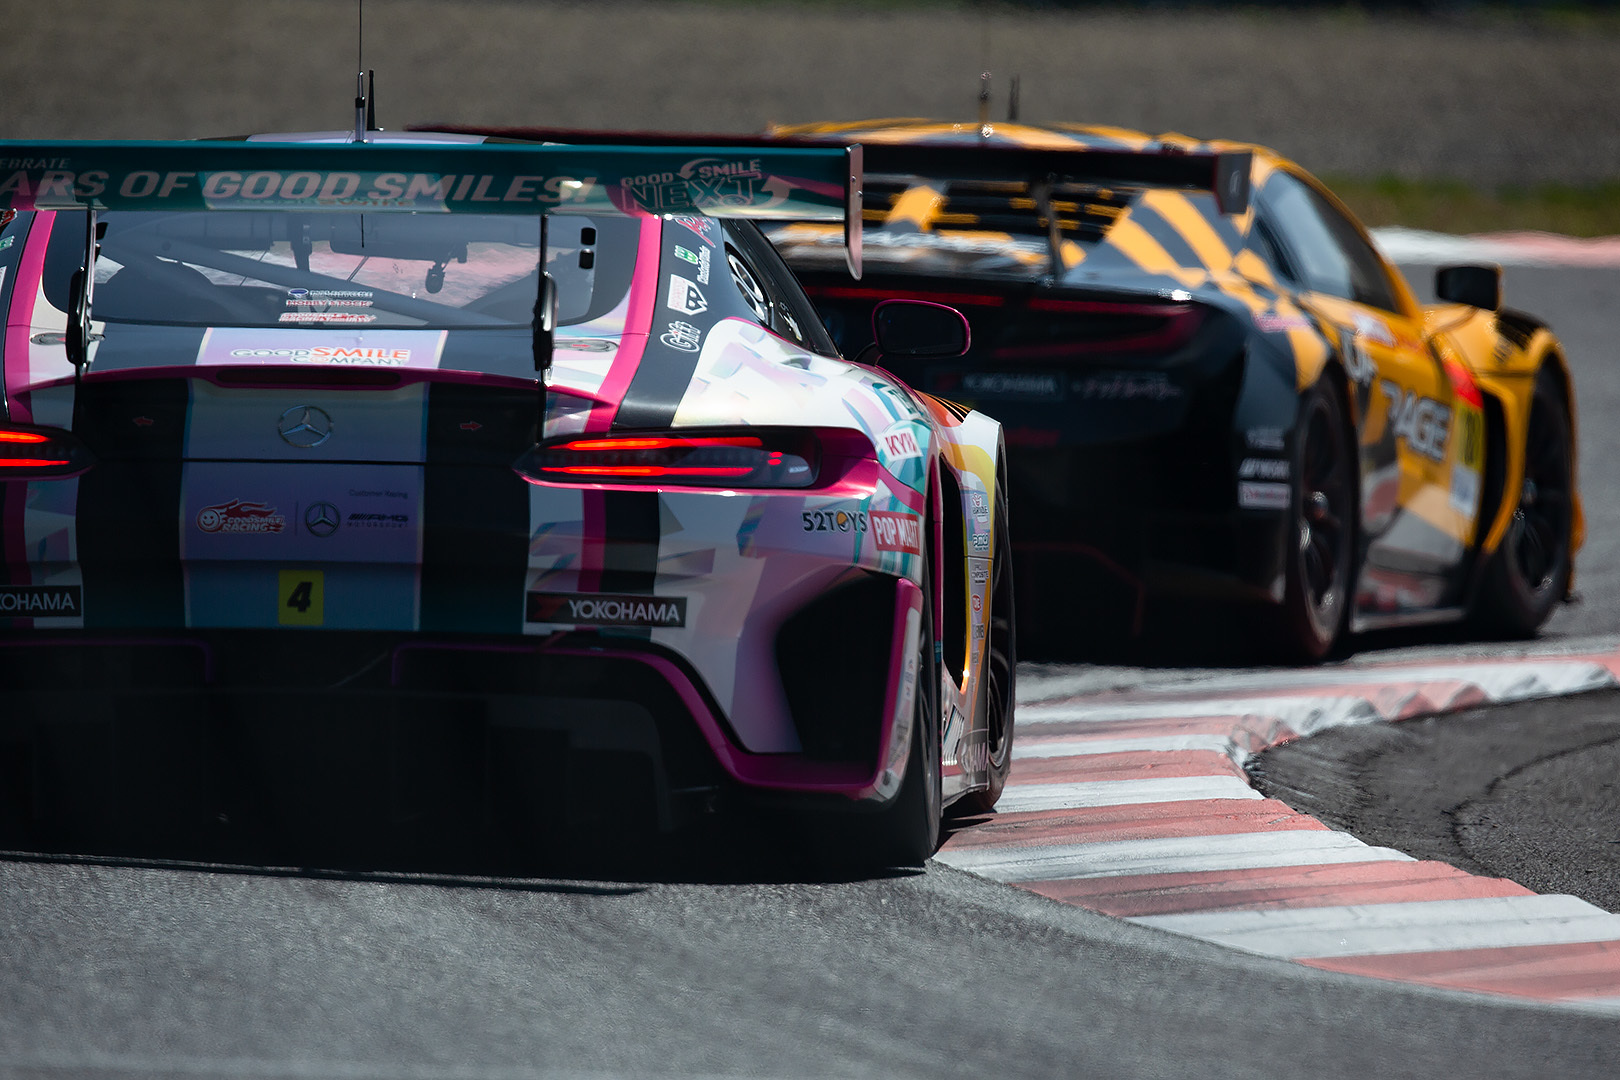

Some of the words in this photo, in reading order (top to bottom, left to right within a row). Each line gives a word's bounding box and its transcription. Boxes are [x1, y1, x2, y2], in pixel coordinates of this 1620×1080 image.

[621, 172, 674, 188] GOOD
[698, 158, 762, 180] SMILE
[0, 170, 110, 197] ARS
[119, 170, 196, 198] OF
[202, 171, 361, 199] GOOD
[367, 172, 597, 202] SMILES!
[292, 356, 404, 365] COMPANY
[801, 511, 869, 533] 52TOYS
[872, 516, 897, 546] POP
[0, 592, 75, 611] OHAMA
[286, 580, 314, 613] 4
[568, 599, 681, 623] YOKOHAMA
